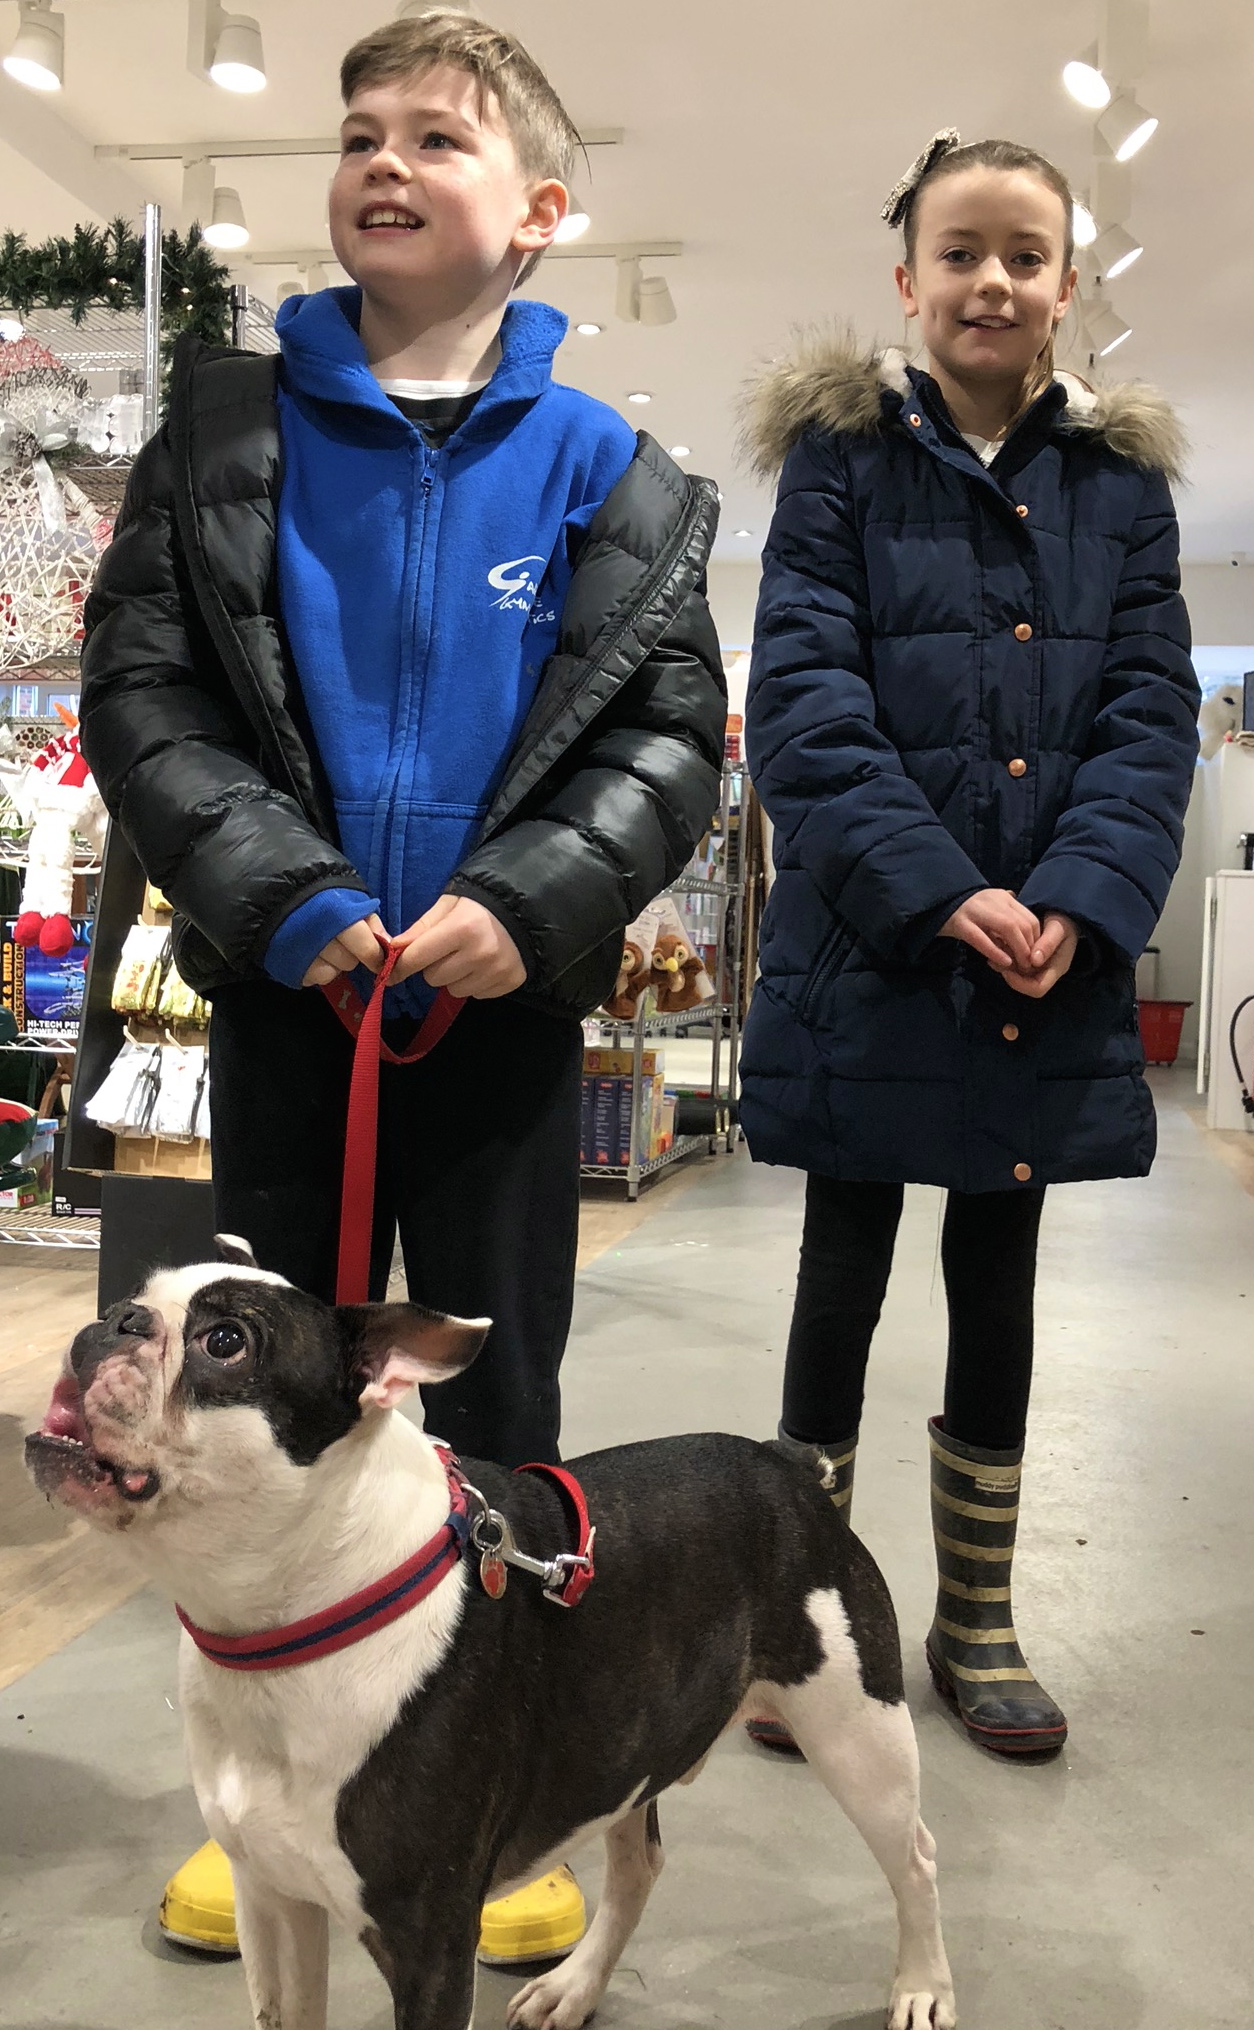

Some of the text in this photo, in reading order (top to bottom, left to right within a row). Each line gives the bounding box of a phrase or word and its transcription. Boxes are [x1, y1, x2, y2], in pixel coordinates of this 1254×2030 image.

[3, 942, 12, 982] BUILD
[27, 1020, 62, 1029] HI-TECH
[56, 1203, 71, 1211] R/C
